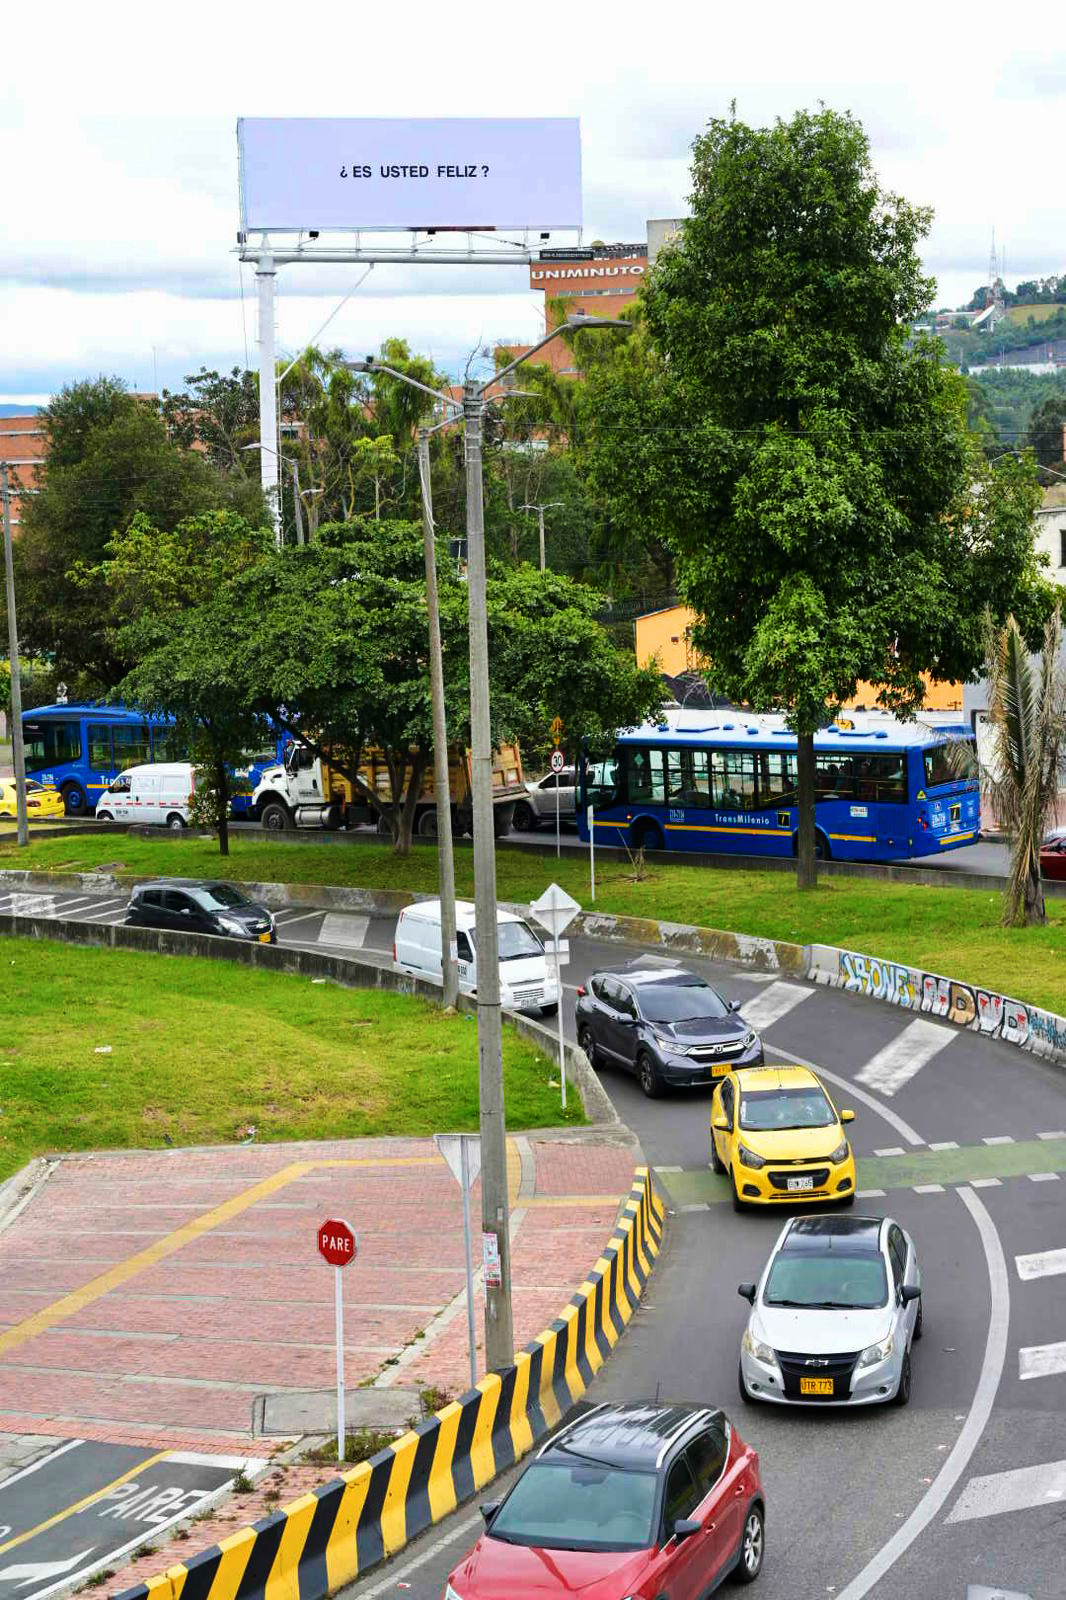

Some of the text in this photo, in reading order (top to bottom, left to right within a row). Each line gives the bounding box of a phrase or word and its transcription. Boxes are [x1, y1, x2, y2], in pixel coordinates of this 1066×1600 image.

[380, 165, 429, 178] USTED
[437, 165, 477, 178] FELIZ
[531, 265, 645, 280] UNIMINUTO
[553, 755, 562, 768] 30
[714, 813, 770, 825] TransMilenio
[322, 1234, 350, 1252] PARE
[800, 1378, 833, 1391] UTR 773
[76, 1483, 213, 1522] PARE
